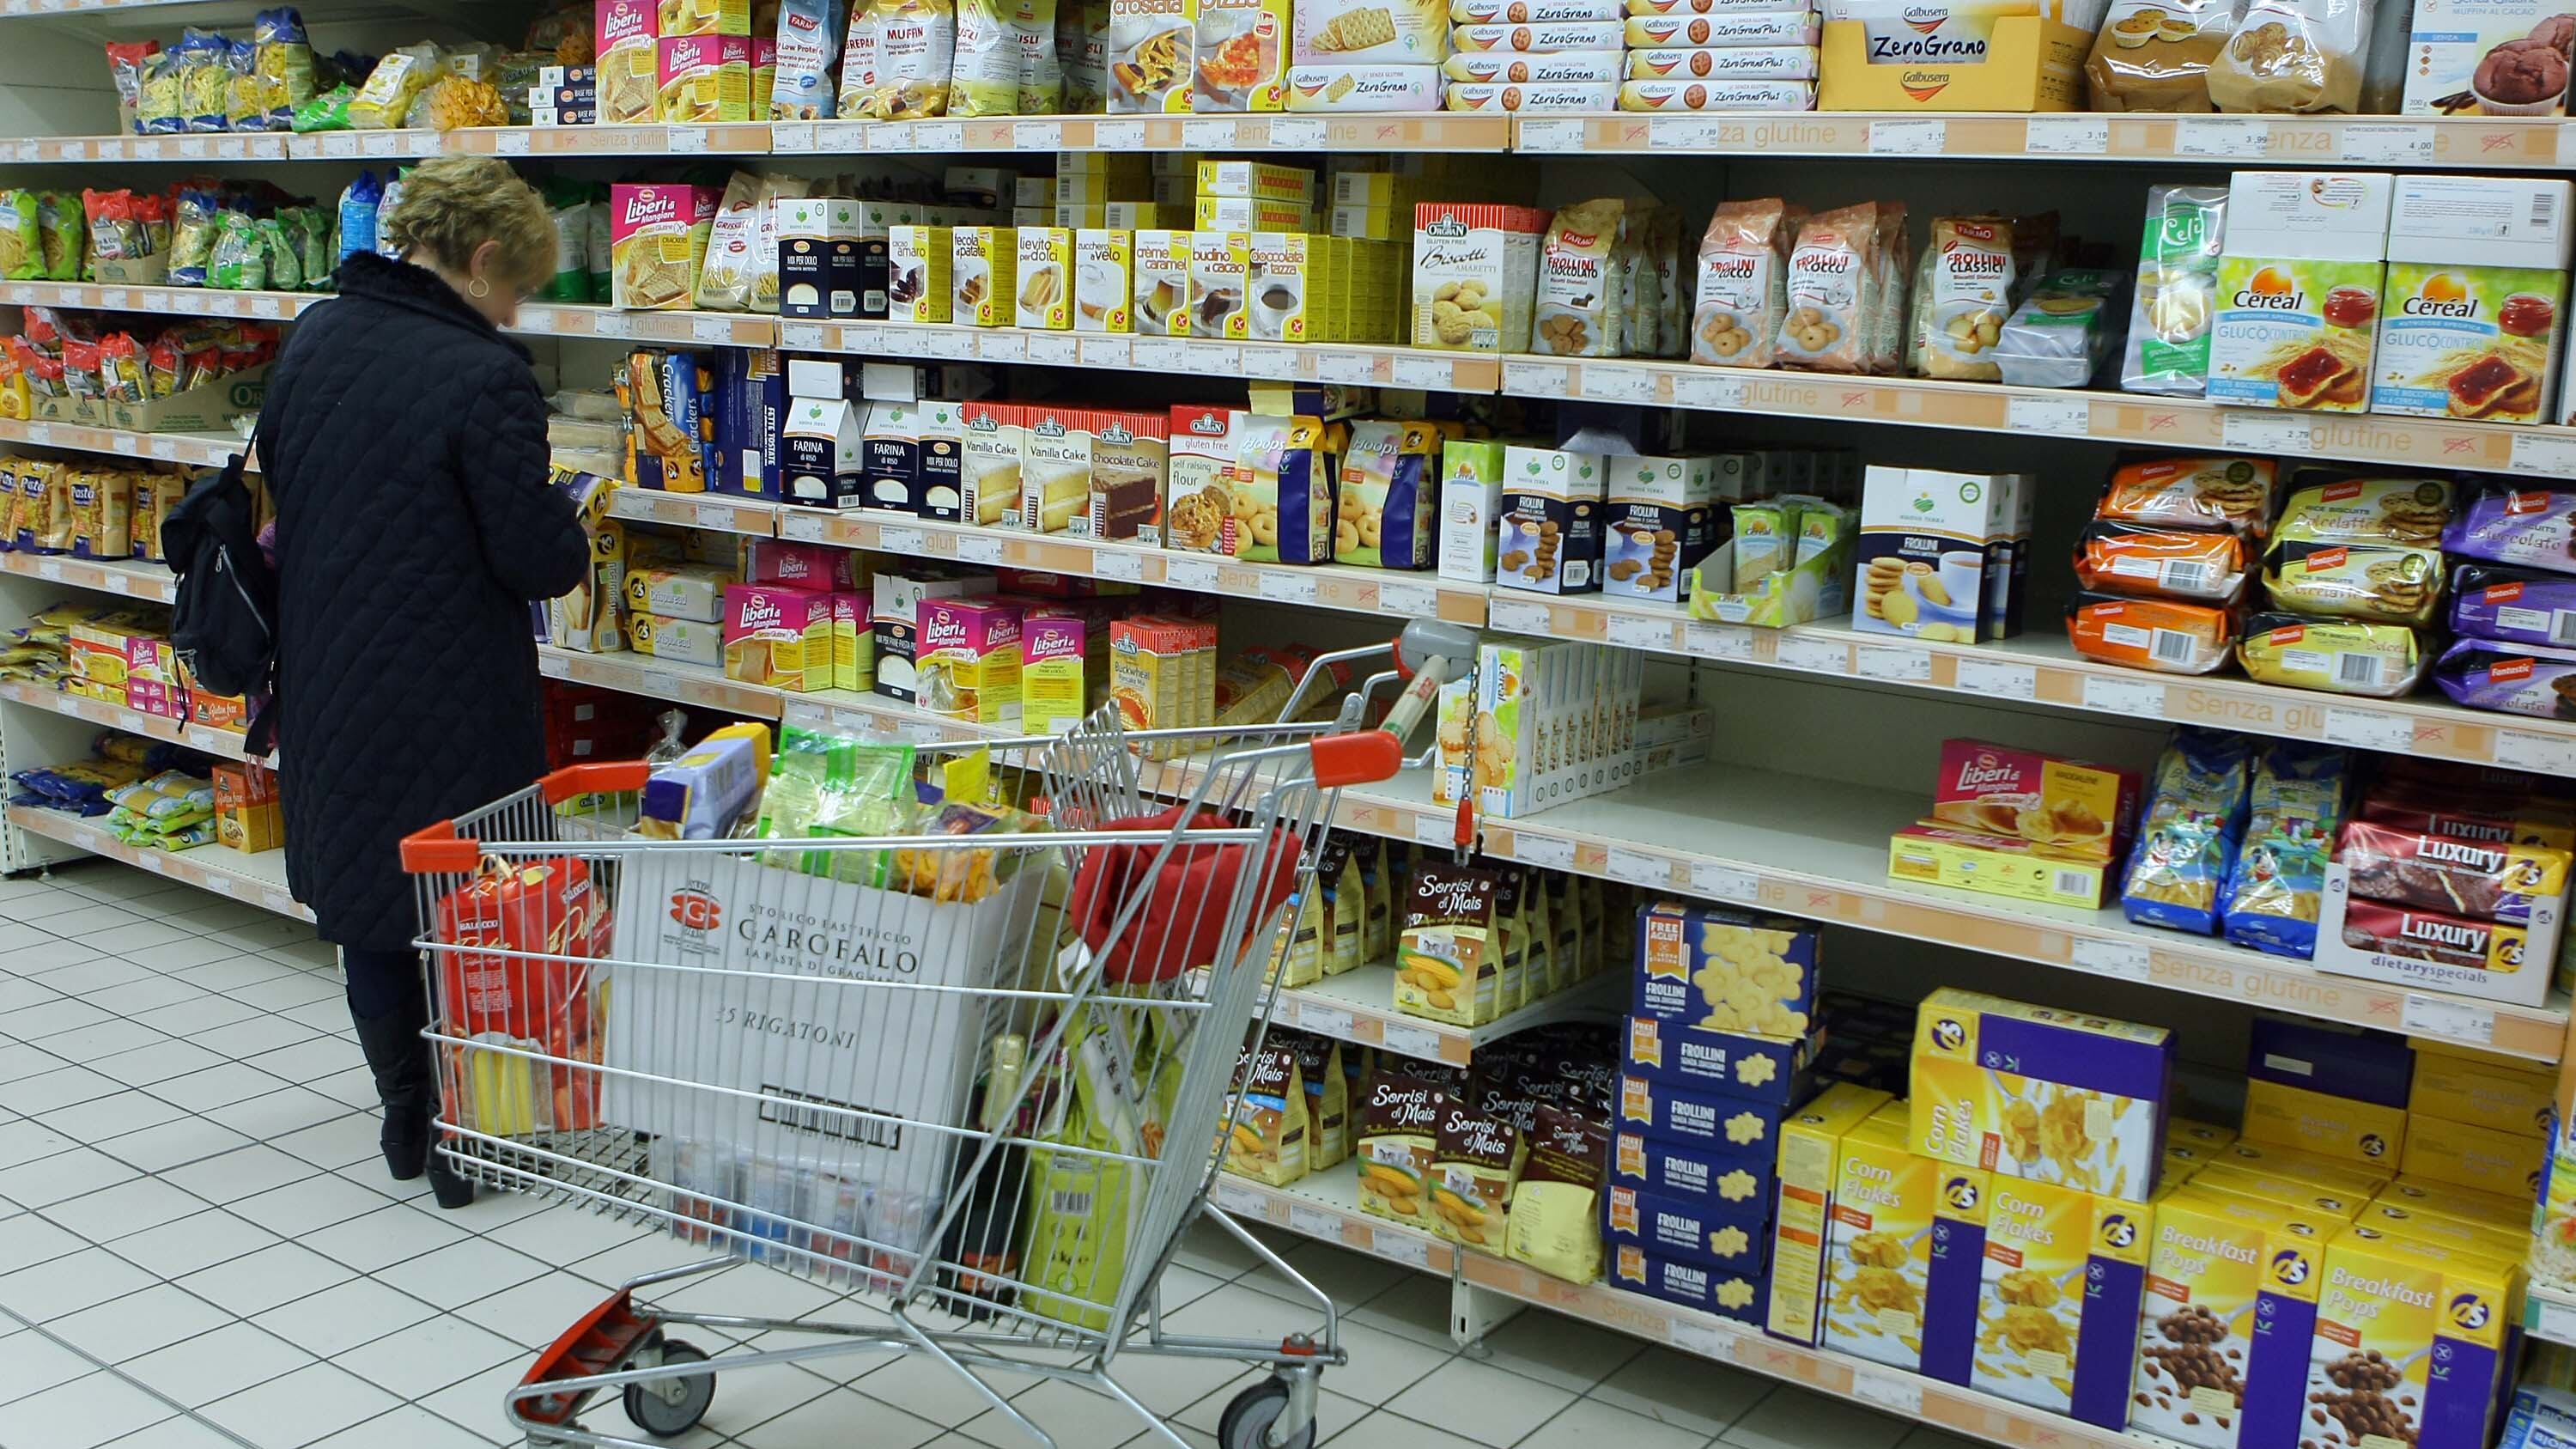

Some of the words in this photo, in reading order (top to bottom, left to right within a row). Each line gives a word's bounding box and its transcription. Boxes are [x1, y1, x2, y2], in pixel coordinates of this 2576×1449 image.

[1467, 3, 1500, 11] Galbusera
[1536, 8, 1593, 19] ZeroGrano
[1904, 7, 1948, 17] Galbusera
[605, 9, 637, 40] Liberi
[617, 24, 641, 37] Mangiare
[1472, 27, 1504, 36] Galbusera
[1644, 20, 1680, 29] Galbusera
[1540, 33, 1596, 45] ZeroGrano
[1874, 36, 1985, 58] ZeroGrano
[670, 42, 696, 72] Liberi
[679, 57, 701, 70] Mangiare
[1647, 52, 1682, 61] Galbusera
[1467, 62, 1501, 70] Galbusera
[1296, 75, 1329, 83] Galbusera
[1537, 69, 1594, 80] ZeroGrano
[1902, 72, 1949, 83] Galbusera
[1357, 81, 1407, 93] ZeroGrano
[1462, 87, 1494, 95] Galbusera
[1640, 85, 1676, 94] Galbusera
[1530, 93, 1587, 105] ZeroGrano
[591, 131, 628, 146] Senza
[1754, 121, 1837, 148] glutine
[625, 196, 667, 224] Liberi
[641, 211, 675, 223] Mangiare
[955, 234, 979, 247] fecola
[1020, 236, 1052, 250] lievito
[1563, 231, 1595, 246] FARMO
[897, 247, 926, 258] amaro
[960, 246, 986, 258] patate
[1031, 248, 1058, 261] dolci
[1095, 248, 1120, 261] velo
[1137, 247, 1169, 259] crème
[1193, 247, 1230, 261] budino
[1420, 245, 1488, 269] Biscotti
[1947, 253, 2007, 265] FROLLINI
[1145, 259, 1188, 271] caramel
[1212, 263, 1245, 273] cacao
[1270, 265, 1297, 275] tazza
[1455, 265, 1497, 274] AMARETTI
[1547, 257, 1595, 270] FROLLINI
[1710, 259, 1755, 272] FROLLINI
[1796, 255, 1849, 271] FROLLINI
[1804, 264, 1845, 274] COCCO
[1949, 262, 2003, 274] CLASSICI
[1551, 267, 1598, 278] CIOCCOLATO
[1719, 269, 1753, 278] COCCO
[2233, 289, 2303, 310] Céréal
[2403, 297, 2477, 317] Céréal
[662, 363, 674, 423] Crackers
[1741, 381, 1818, 405] glutine
[686, 398, 699, 454] Crackers
[2310, 421, 2411, 452] glutine
[793, 440, 823, 453] FARINA
[874, 443, 905, 456] FARINA
[966, 441, 993, 453] Vanilla
[994, 444, 1017, 455] Cake
[1185, 439, 1210, 451] gluten
[1212, 440, 1229, 451] free
[1243, 437, 1286, 452] Hoops
[1352, 438, 1400, 456] Hoops
[1030, 446, 1060, 459] Vanilla
[1062, 449, 1086, 461] Cake
[1092, 453, 1135, 466] Chocolate
[1136, 457, 1159, 468] Cake
[1173, 460, 1186, 470] self
[1187, 462, 1212, 472] raising
[1173, 471, 1197, 486] flour
[71, 487, 94, 499] Pasta
[2324, 486, 2359, 497] Fantastic
[1630, 505, 1659, 518] FROLLINI
[2328, 507, 2370, 515] BISCUITS
[2512, 521, 2556, 533] BISCUITS
[1904, 537, 1938, 551] FROLLINI
[2477, 526, 2561, 551] Cioccolato
[2308, 552, 2345, 567] Fantastic
[778, 560, 803, 578] Liberi
[2487, 588, 2520, 599] Fantastic
[740, 603, 775, 629] Liberi
[2093, 606, 2123, 615] Fantastic
[754, 618, 781, 628] Mangiare
[927, 617, 959, 644] Liberi
[987, 624, 1015, 646] Liberi
[2271, 630, 2302, 641] Fantastic
[938, 636, 966, 646] Mangiare
[1031, 636, 1068, 655] Liberi
[1046, 646, 1075, 655] Mangiare
[1115, 661, 1151, 680] Buckwheat
[2492, 663, 2530, 677] Fantastic
[2186, 691, 2273, 721] Senza
[1956, 761, 2012, 791] Liberi
[1977, 782, 2018, 793] Mangiare
[2416, 835, 2502, 874] Luxury
[1419, 874, 1475, 897] Sorrisi
[1446, 893, 1482, 916] Mais
[1650, 922, 1679, 933] FREE
[2400, 912, 2488, 953] Luxury
[738, 918, 918, 975] GAROFALO
[2150, 950, 2233, 988] Senza
[2244, 972, 2342, 1008] glutine
[1645, 982, 1686, 995] FROLLINI
[744, 1014, 855, 1050] RIGATONI
[1635, 1021, 1654, 1032] FREE
[1680, 1042, 1726, 1062] FROLLINI
[1250, 1063, 1284, 1085] Mais
[1518, 1075, 1566, 1094] Sorrisi
[1625, 1079, 1644, 1089] FREE
[1373, 1084, 1428, 1106] Sorrisi
[1482, 1091, 1536, 1114] Sorrisi
[1398, 1103, 1436, 1125] Mais
[1671, 1099, 1716, 1121] FROLLINI
[1445, 1111, 1498, 1135] Sorrisi
[1924, 1103, 1949, 1155] Corn
[1949, 1097, 1973, 1160] Flakes
[1552, 1125, 1584, 1142] Sorrisi
[1467, 1132, 1506, 1155] Mais
[1664, 1156, 1709, 1178] FROLLINI
[1845, 1157, 1893, 1184] Corn
[1843, 1179, 1901, 1209] Flakes
[1996, 1192, 2045, 1220] Corn
[1656, 1212, 1700, 1234] FROLLINI
[1995, 1215, 2055, 1245] Flakes
[2160, 1225, 2258, 1266] Breakfast
[2159, 1247, 2207, 1276] Pops
[1663, 1263, 1707, 1285] FROLLINI
[2330, 1266, 2436, 1309] Breakfast
[2329, 1291, 2379, 1319] Pops
